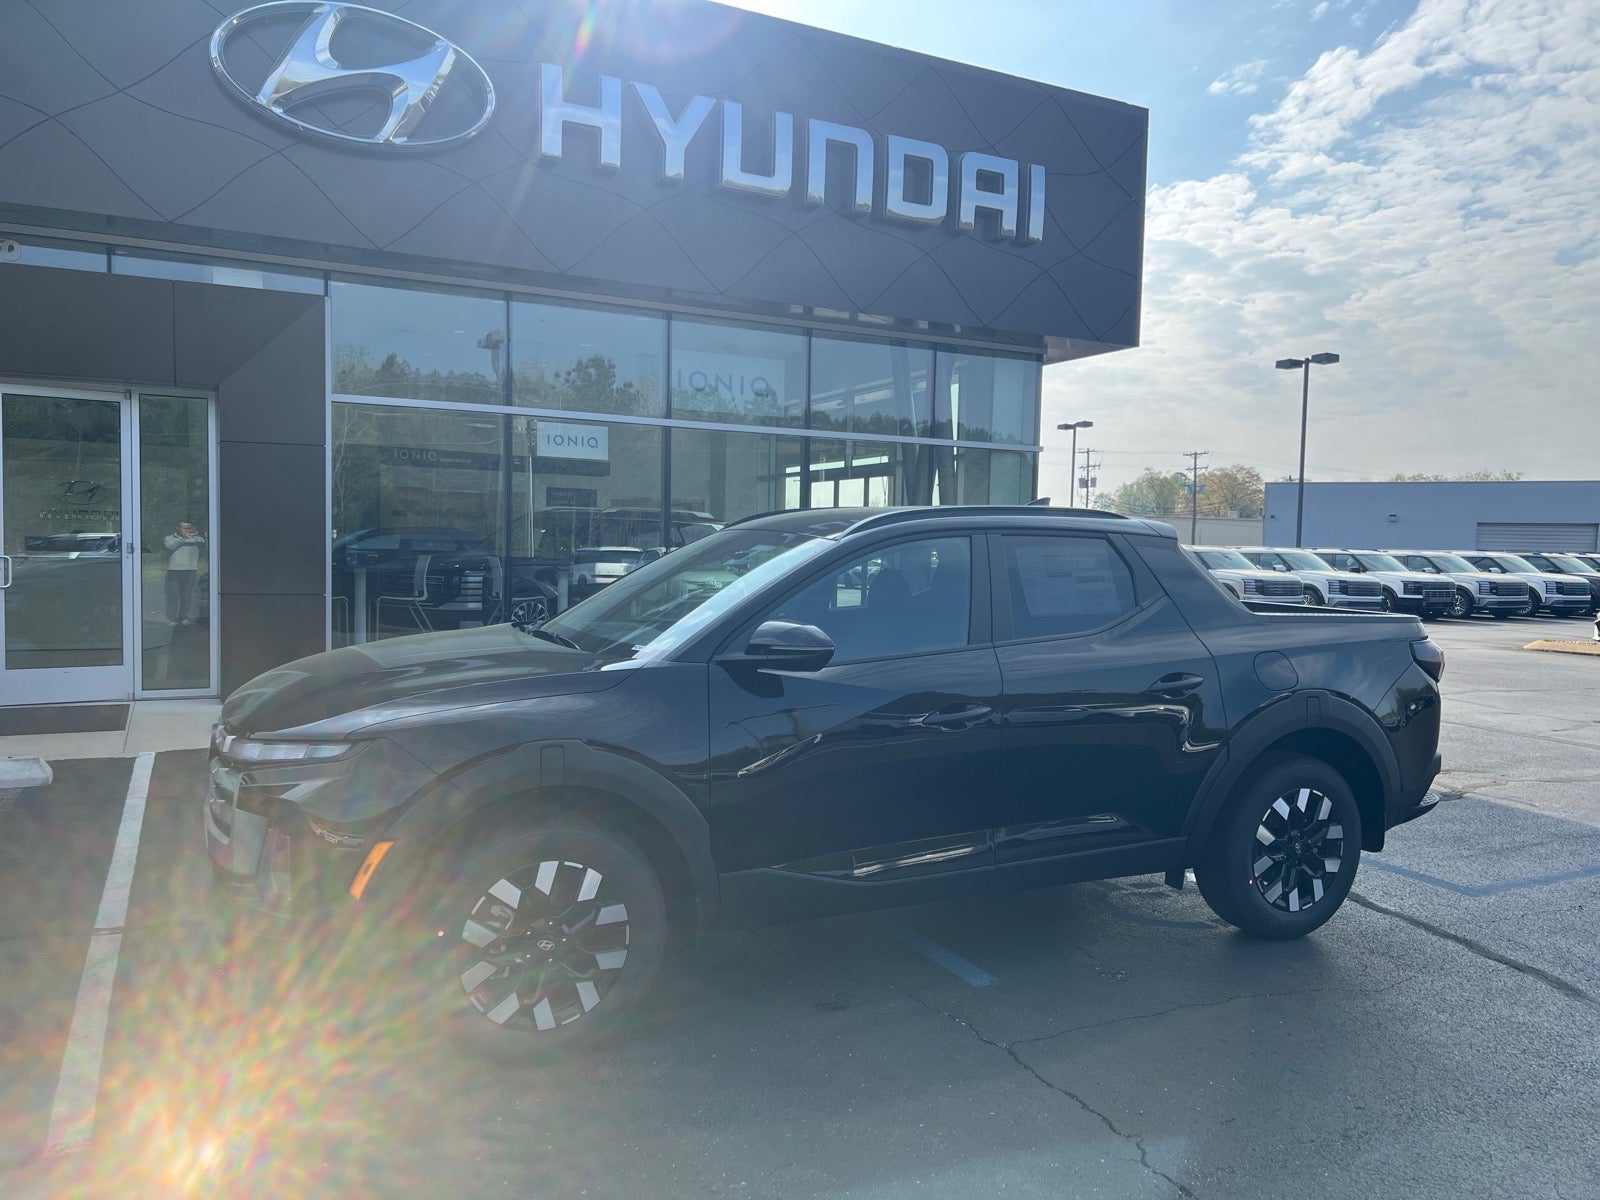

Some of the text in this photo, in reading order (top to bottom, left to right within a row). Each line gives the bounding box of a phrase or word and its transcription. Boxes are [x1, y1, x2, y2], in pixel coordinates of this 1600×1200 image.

[540, 62, 1046, 243] HYUNDAI
[677, 368, 769, 397] IONIQ
[547, 433, 599, 448] IONIQ
[393, 448, 438, 462] IONIQ
